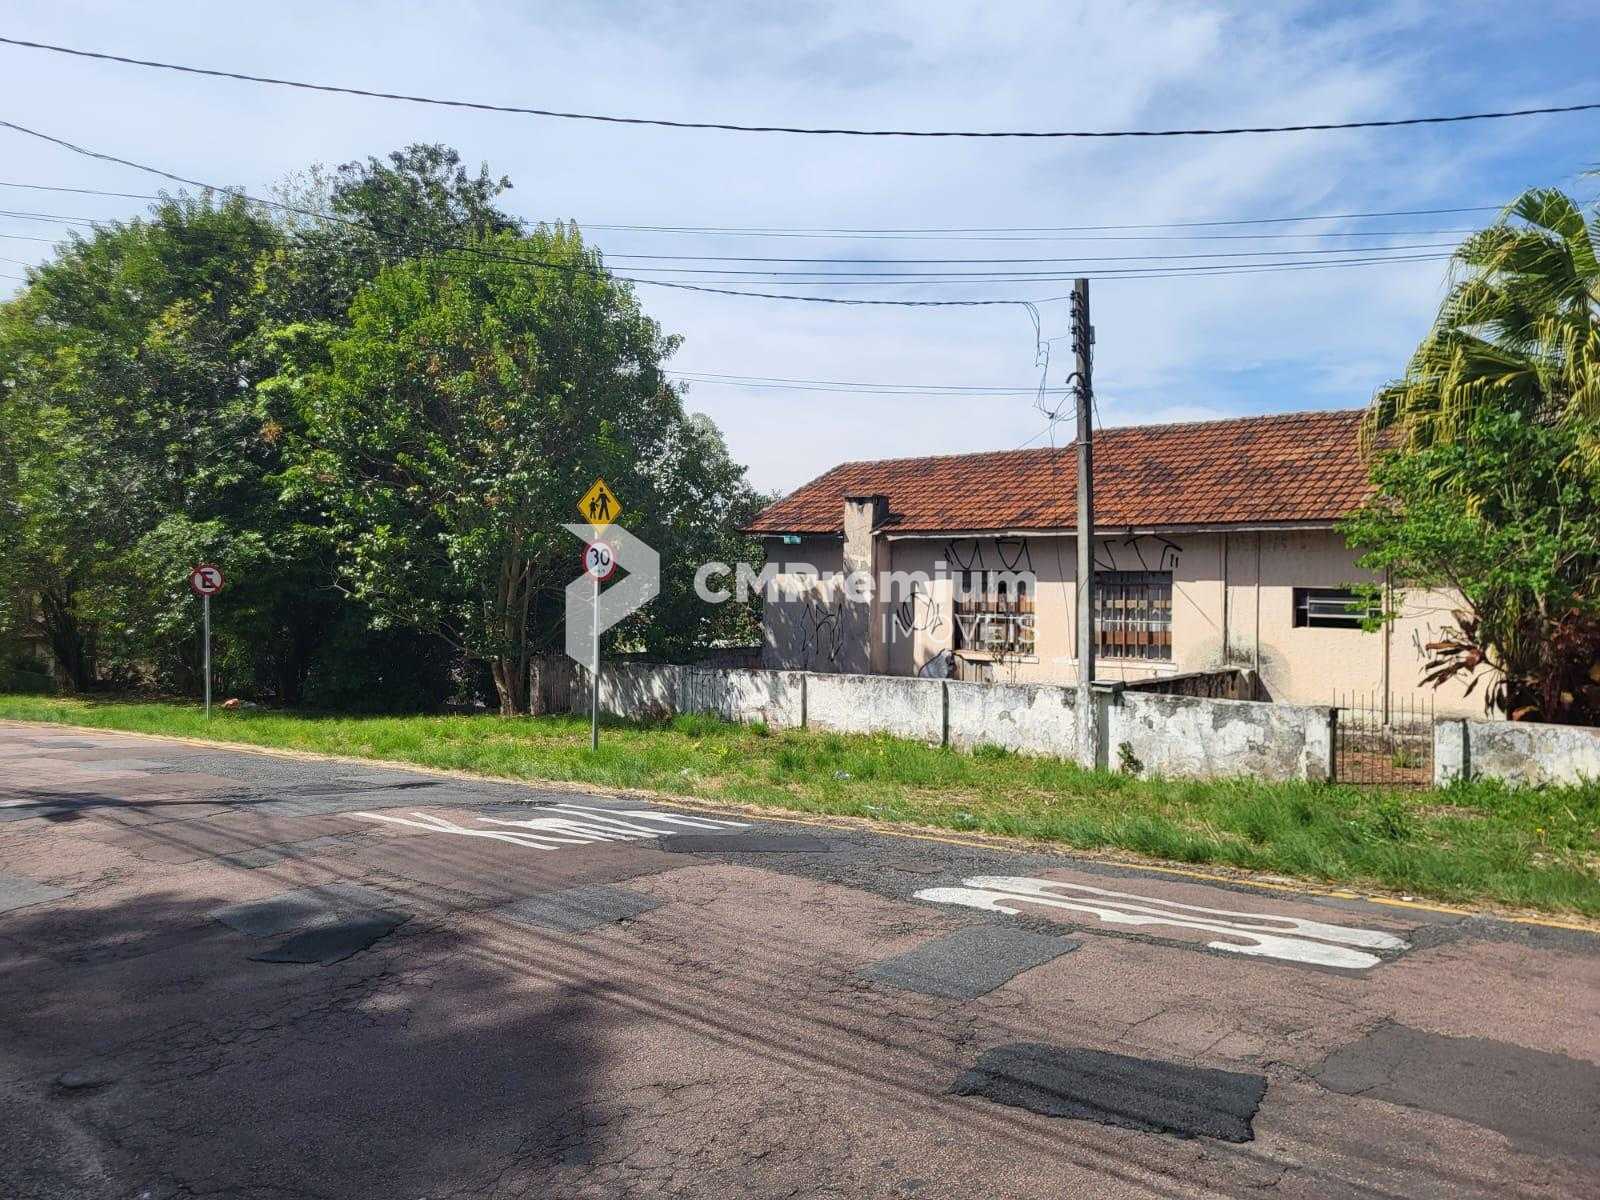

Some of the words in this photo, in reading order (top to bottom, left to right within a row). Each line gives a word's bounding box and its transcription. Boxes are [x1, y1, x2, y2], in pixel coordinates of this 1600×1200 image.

[590, 547, 610, 566] 30
[202, 571, 214, 588] E
[913, 875, 1412, 969] 30
